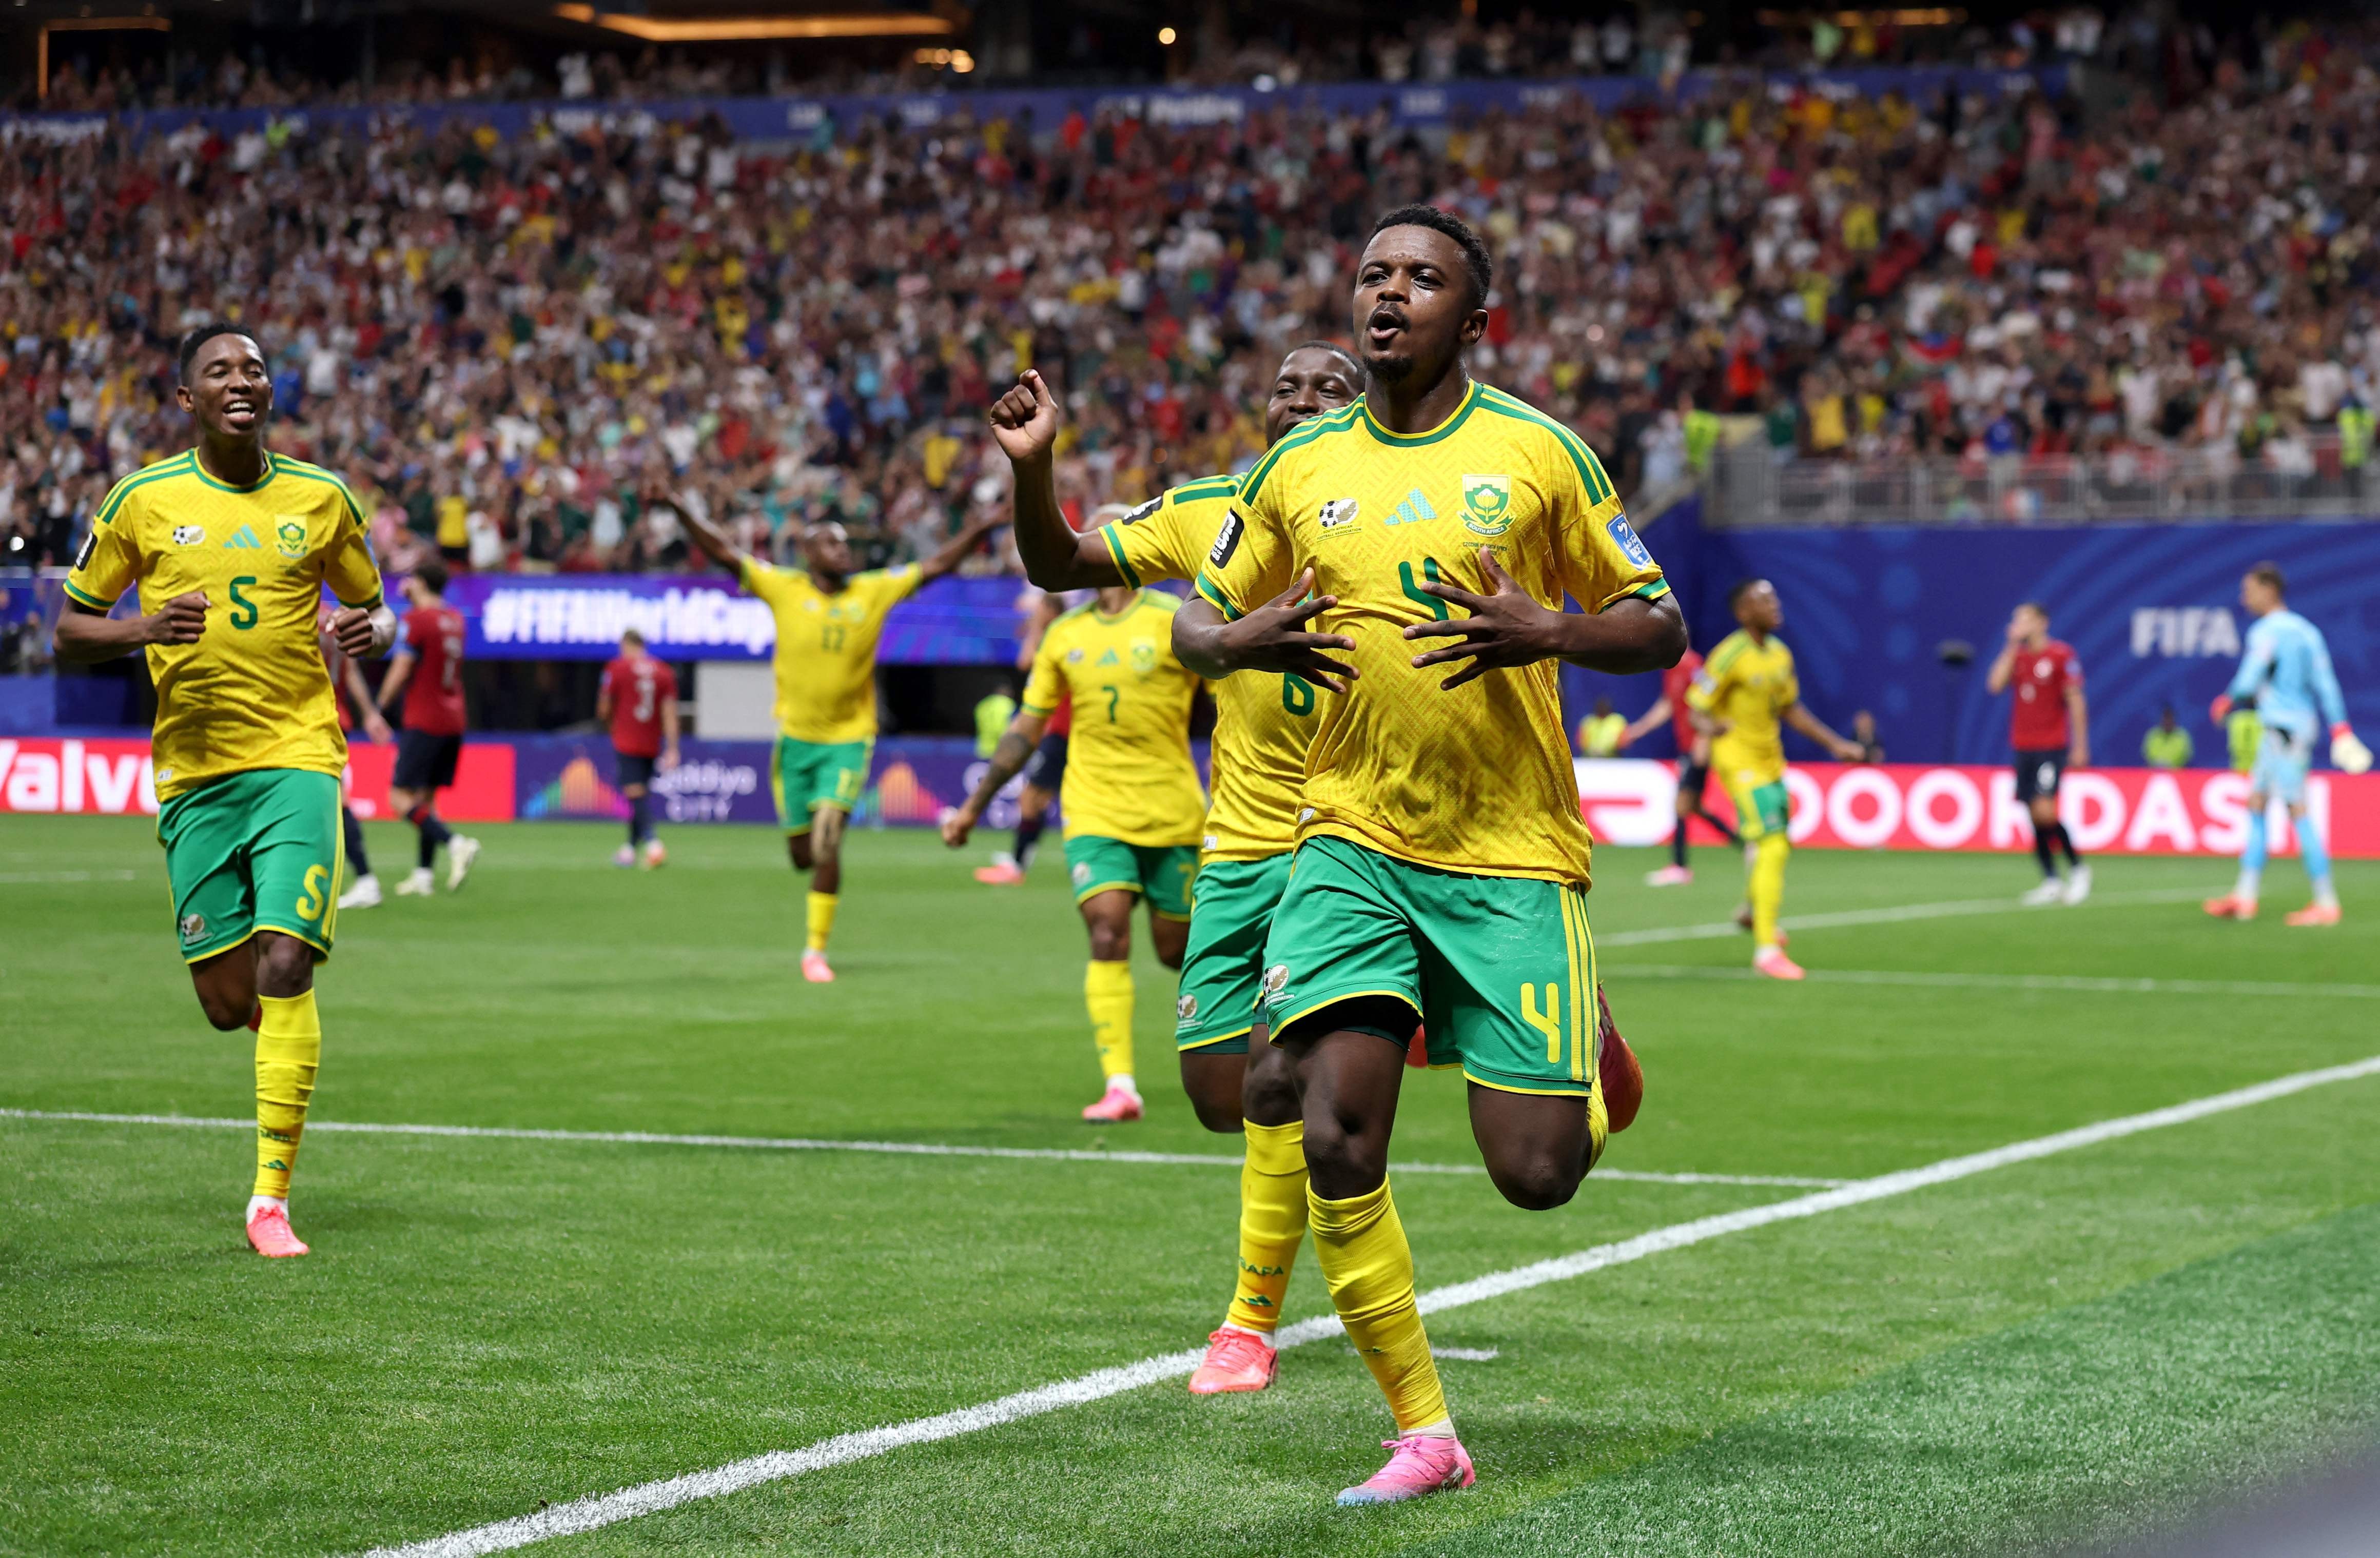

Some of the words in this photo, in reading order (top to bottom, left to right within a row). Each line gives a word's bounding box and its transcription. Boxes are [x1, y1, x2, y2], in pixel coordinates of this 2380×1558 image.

[1468, 523, 1486, 534] SOUTH
[229, 576, 258, 630] 5
[1398, 557, 1449, 621] 4
[482, 588, 776, 656] #FIFAWorldCup
[2130, 606, 2241, 658] FIFA
[1102, 686, 1119, 724] 7
[1284, 673, 1315, 716] 6
[296, 863, 329, 921] 5
[1177, 863, 1195, 905] 7
[1520, 982, 1560, 1063] 4
